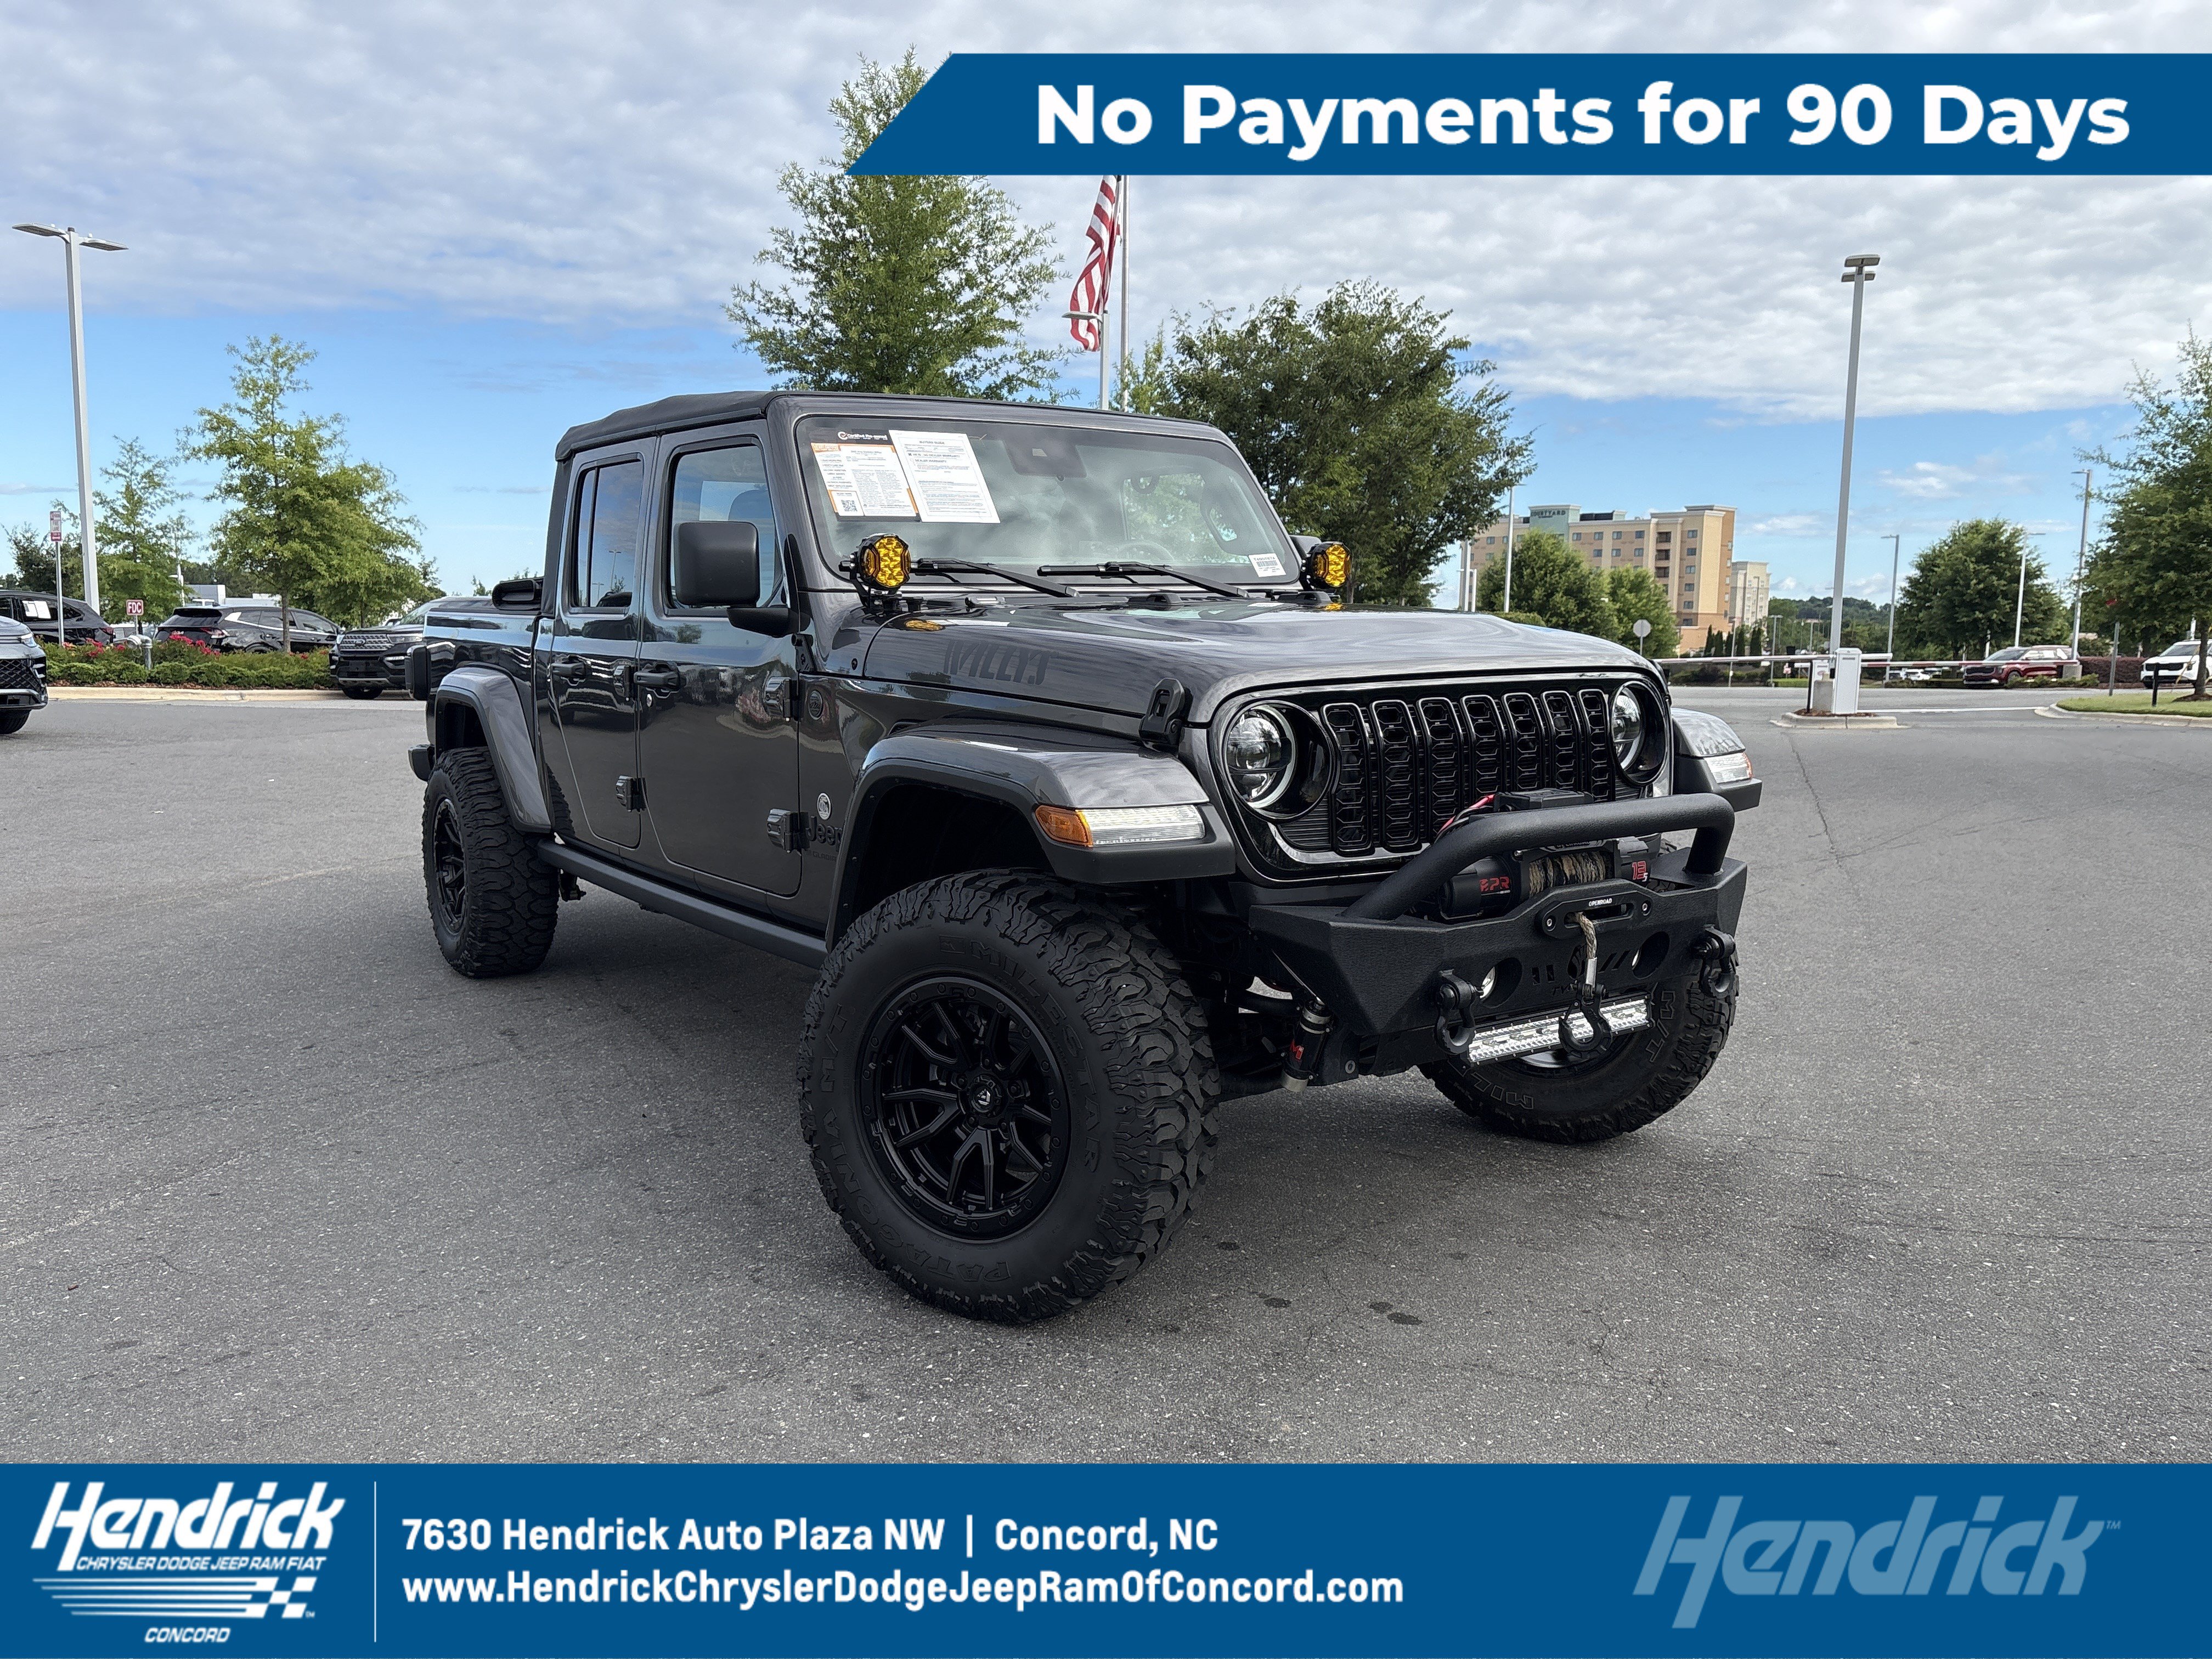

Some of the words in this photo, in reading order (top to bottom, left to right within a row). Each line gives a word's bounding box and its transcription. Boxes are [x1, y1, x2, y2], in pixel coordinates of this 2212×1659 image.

[128, 602, 142, 613] FDC
[944, 640, 1050, 685] WILLYS
[1588, 898, 1612, 906] OPENROAD
[820, 1003, 848, 1092] M/T
[970, 941, 1101, 1172] MILESTAR
[1646, 990, 1675, 1063] M/T
[823, 1107, 1011, 1282] PATAGONIA
